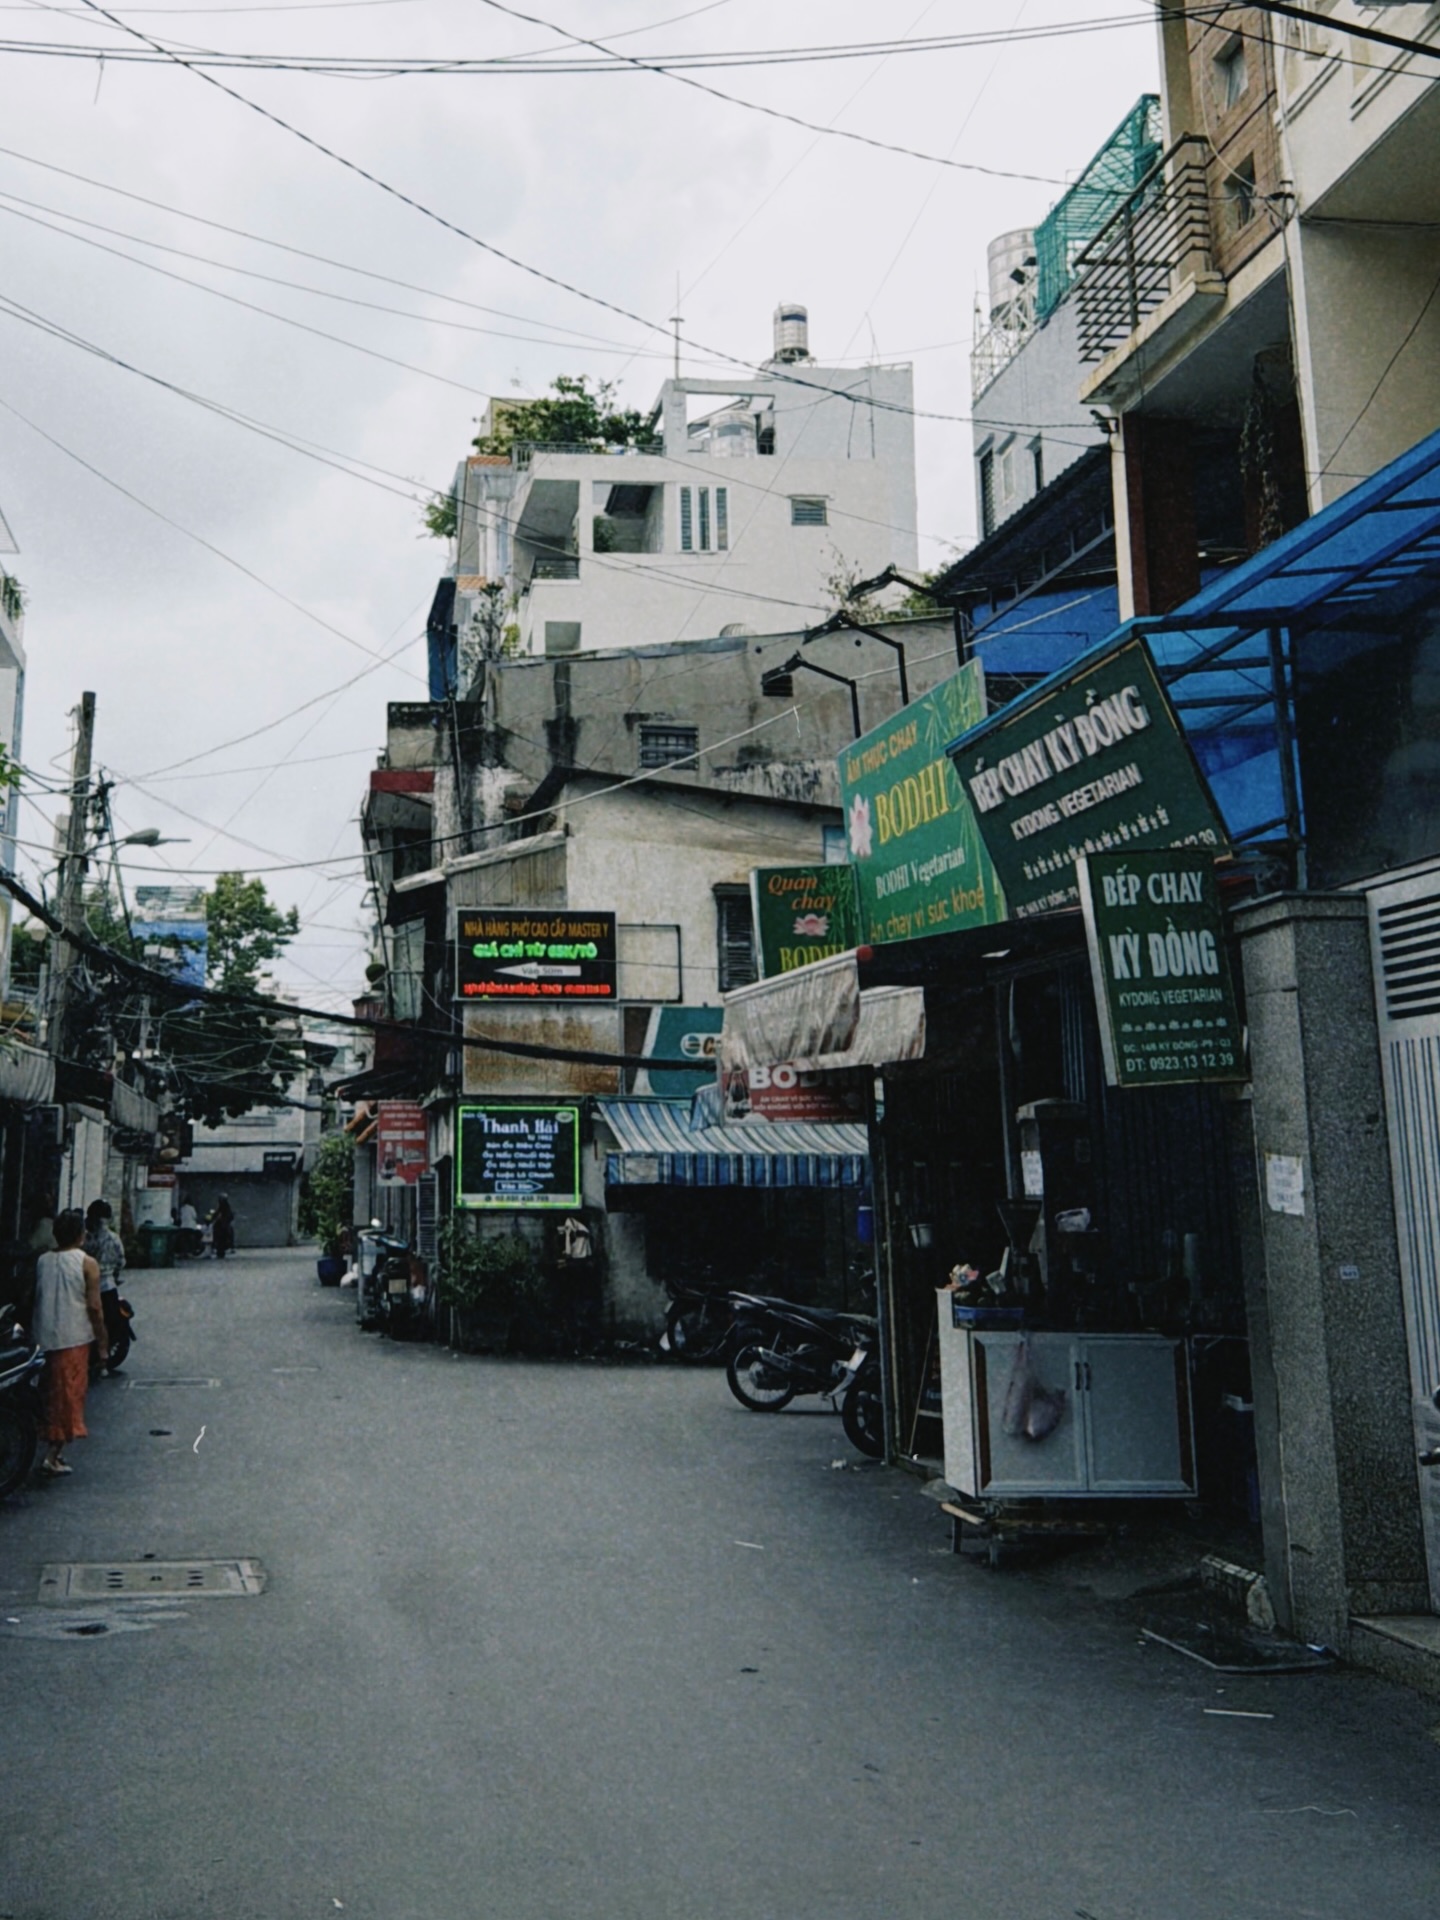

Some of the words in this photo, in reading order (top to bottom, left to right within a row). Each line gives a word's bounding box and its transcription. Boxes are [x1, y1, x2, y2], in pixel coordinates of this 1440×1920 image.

[889, 720, 917, 758] CHAY
[969, 757, 1004, 814] BẾP
[998, 738, 1054, 797] CHAY
[1043, 713, 1085, 773] KỲ
[1073, 684, 1151, 757] ĐỒNG
[875, 758, 950, 845] BODHI
[1010, 803, 1061, 841] KYDONG
[1056, 763, 1143, 818] VEGETARIAN
[875, 864, 909, 899] BODHI
[909, 845, 965, 886] Vegetarian
[1102, 864, 1140, 907] BẾP
[1146, 871, 1203, 904] CHAY
[791, 891, 836, 912] chay
[464, 916, 485, 937] NHÀ
[485, 916, 510, 937] HÀNG
[531, 922, 549, 937] CAO
[568, 922, 601, 938] MASTER
[886, 909, 912, 939] chay
[1108, 926, 1141, 980] KỲ
[1147, 916, 1219, 978] ĐỒNG
[1119, 990, 1161, 1007] KYDONG
[1161, 988, 1223, 1005] VEGETARIAN
[1202, 1053, 1217, 1067] 12
[1219, 1052, 1234, 1066] 39
[481, 1117, 530, 1134] Thanh
